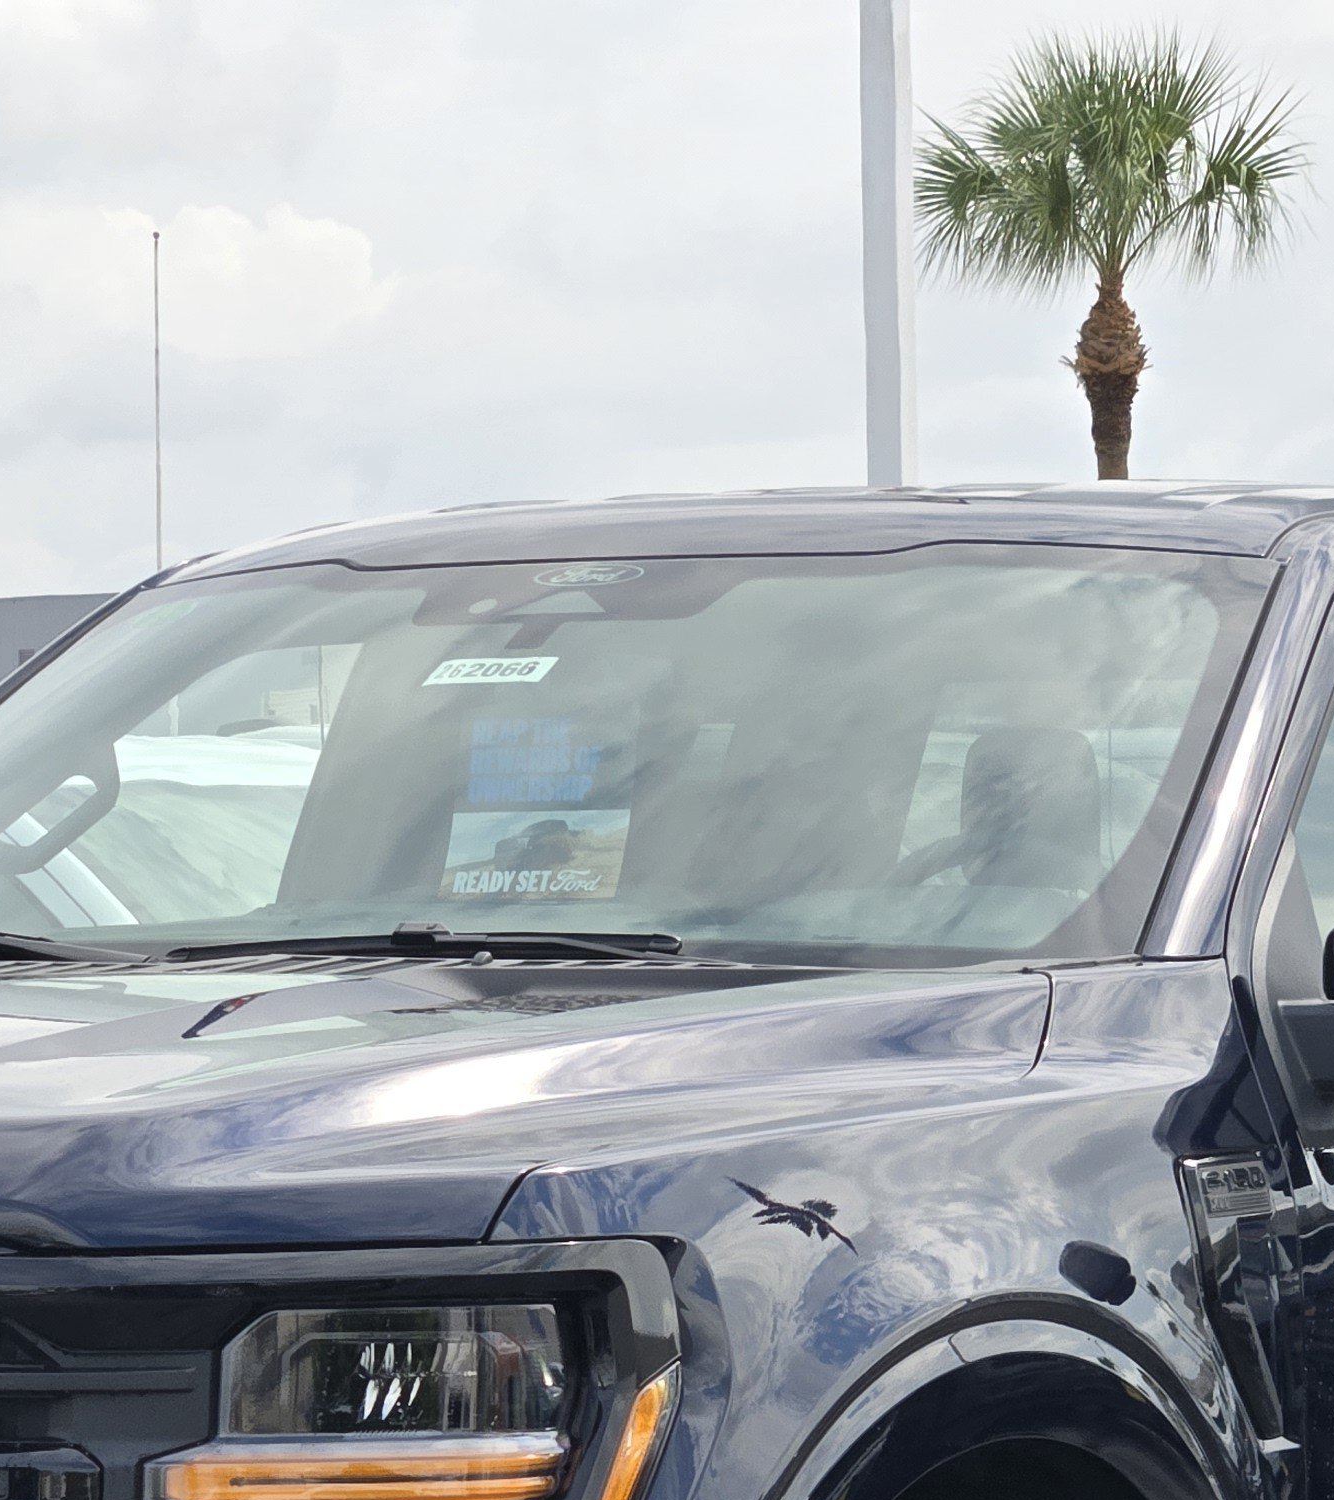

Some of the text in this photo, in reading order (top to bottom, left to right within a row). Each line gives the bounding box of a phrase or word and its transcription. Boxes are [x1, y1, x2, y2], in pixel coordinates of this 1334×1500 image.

[549, 566, 627, 584] Ford
[452, 868, 603, 895] READY SET Ford
